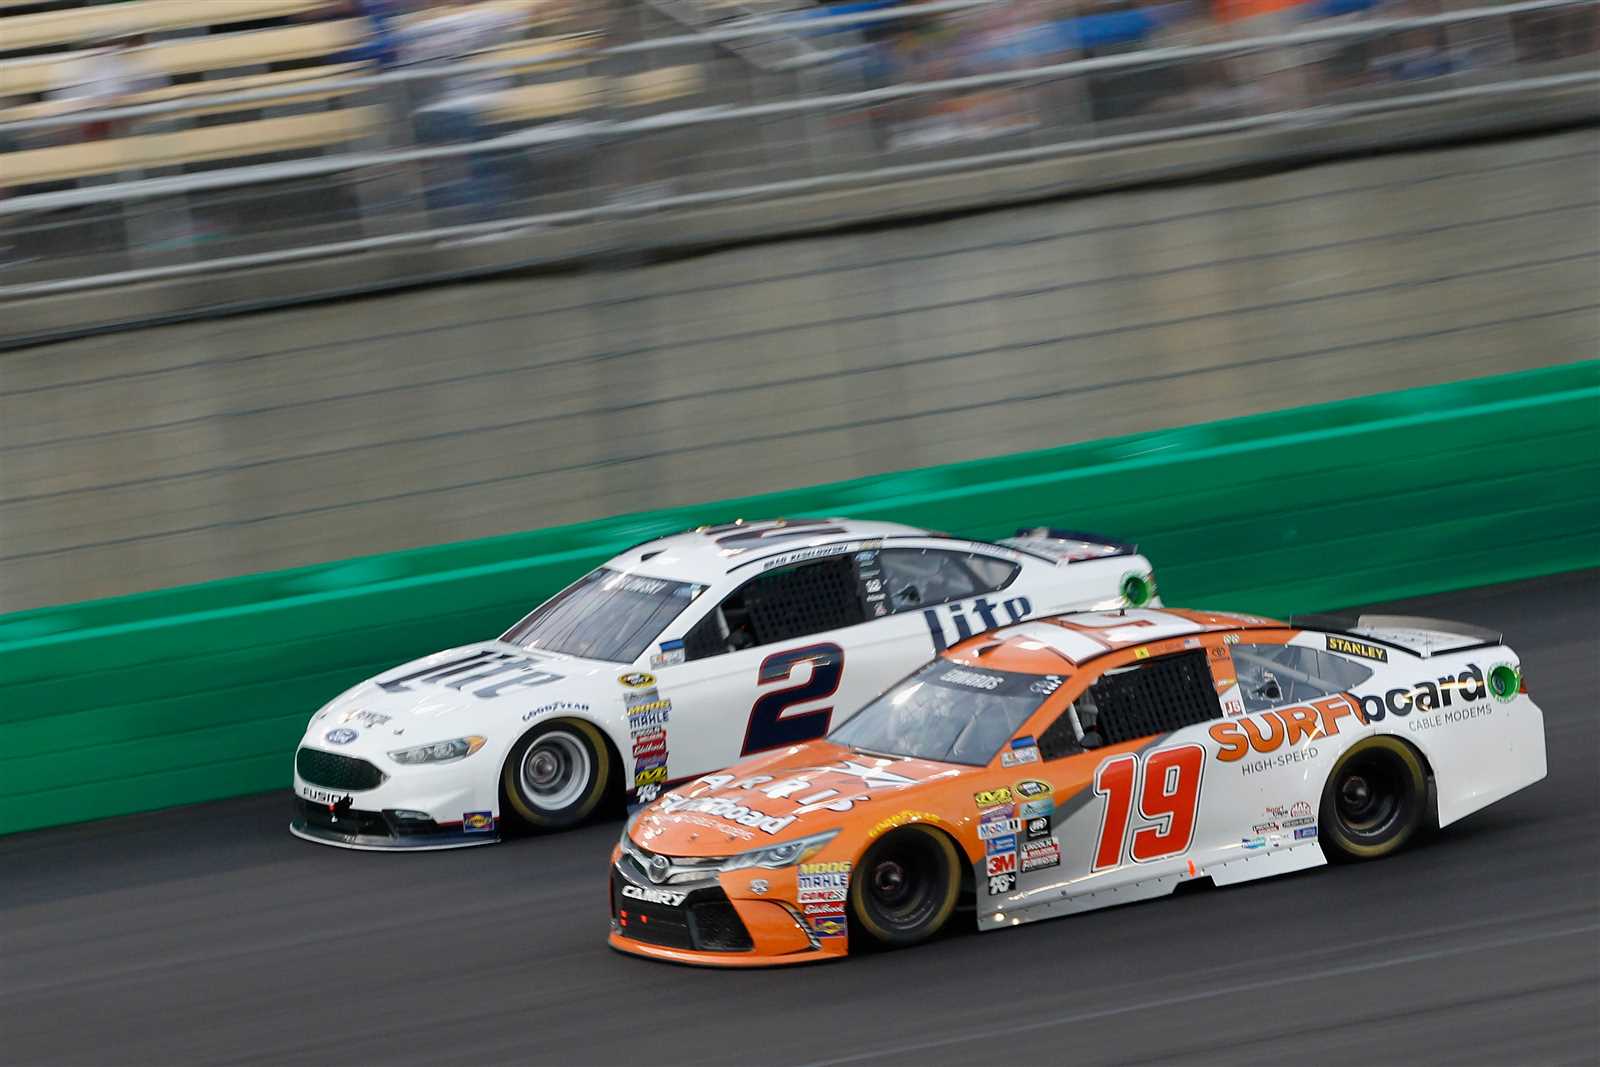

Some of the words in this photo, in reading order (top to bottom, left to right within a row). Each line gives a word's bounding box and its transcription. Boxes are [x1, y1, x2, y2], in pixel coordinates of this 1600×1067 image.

[1329, 637, 1383, 660] STANLEY
[739, 641, 845, 758] 2
[1408, 715, 1442, 732] CABLE
[1444, 703, 1493, 725] MODEMS
[1241, 747, 1319, 777] HIGH-SPEED
[1091, 743, 1207, 874] 19
[989, 853, 1015, 874] 3M
[800, 874, 847, 889] MAHLE
